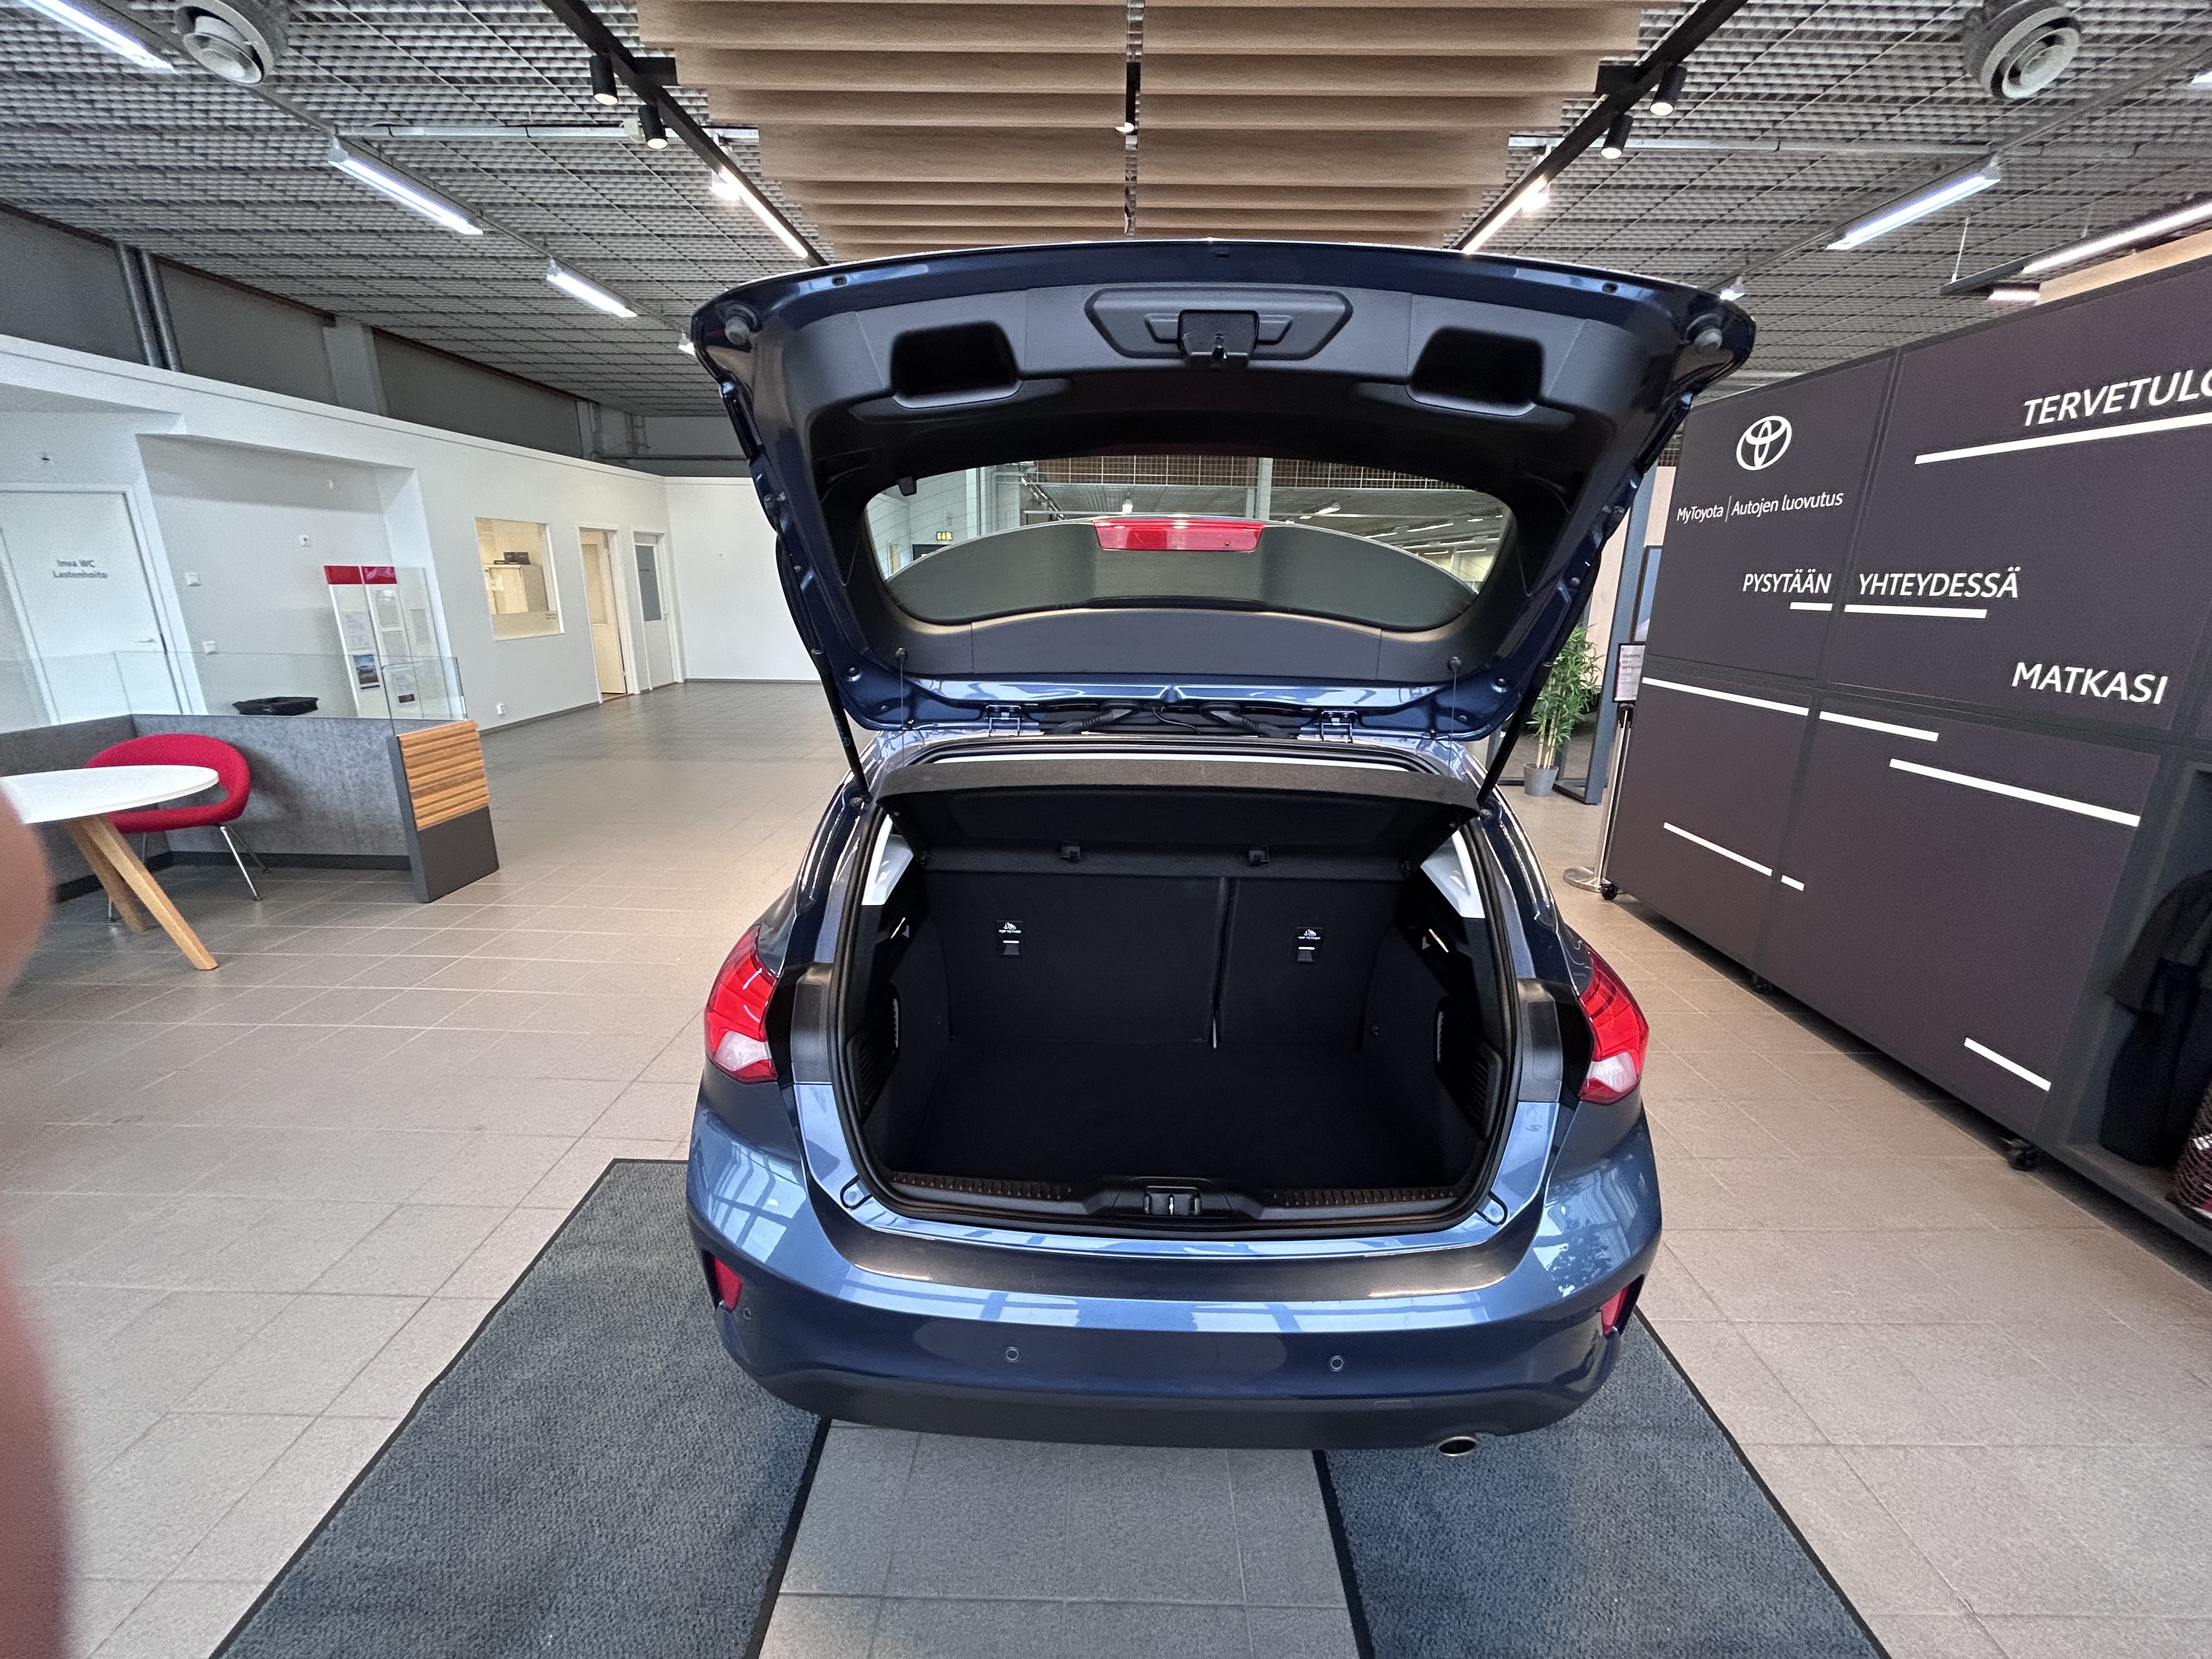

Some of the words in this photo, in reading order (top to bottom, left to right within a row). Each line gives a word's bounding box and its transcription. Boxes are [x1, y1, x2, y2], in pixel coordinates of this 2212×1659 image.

[1677, 505, 1724, 524] MyToyota
[1731, 498, 1779, 517] Autojen
[1781, 492, 1844, 511] luovutus
[53, 571, 108, 579] Lastenhoito
[1742, 568, 1832, 594] PYSYTÄÄN
[1859, 566, 2021, 598] YHTEYDESSÄ
[2012, 662, 2168, 704] MATKASI
